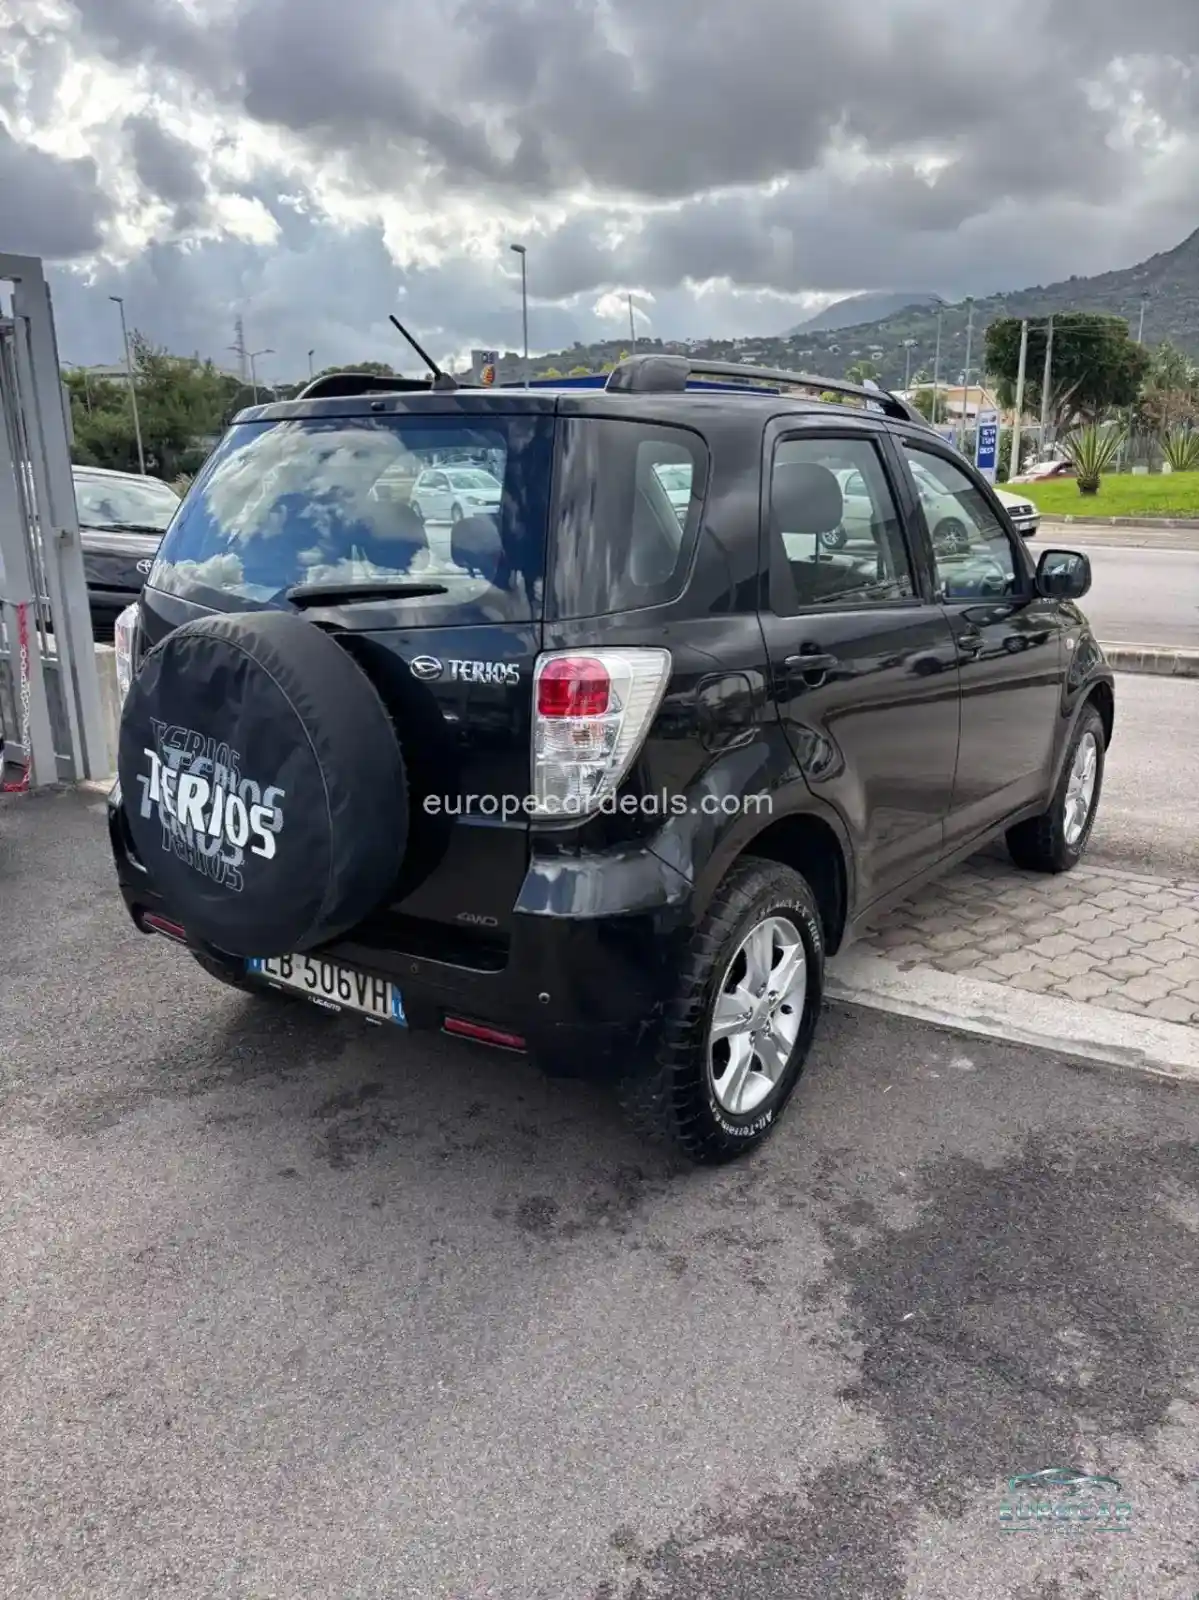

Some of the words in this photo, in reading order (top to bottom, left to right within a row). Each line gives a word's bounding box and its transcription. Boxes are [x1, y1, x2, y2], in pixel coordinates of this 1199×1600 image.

[448, 659, 520, 685] TERIOS
[144, 748, 276, 860] TERIOS
[456, 911, 498, 927] 4WD
[304, 955, 388, 1014] 506VH
